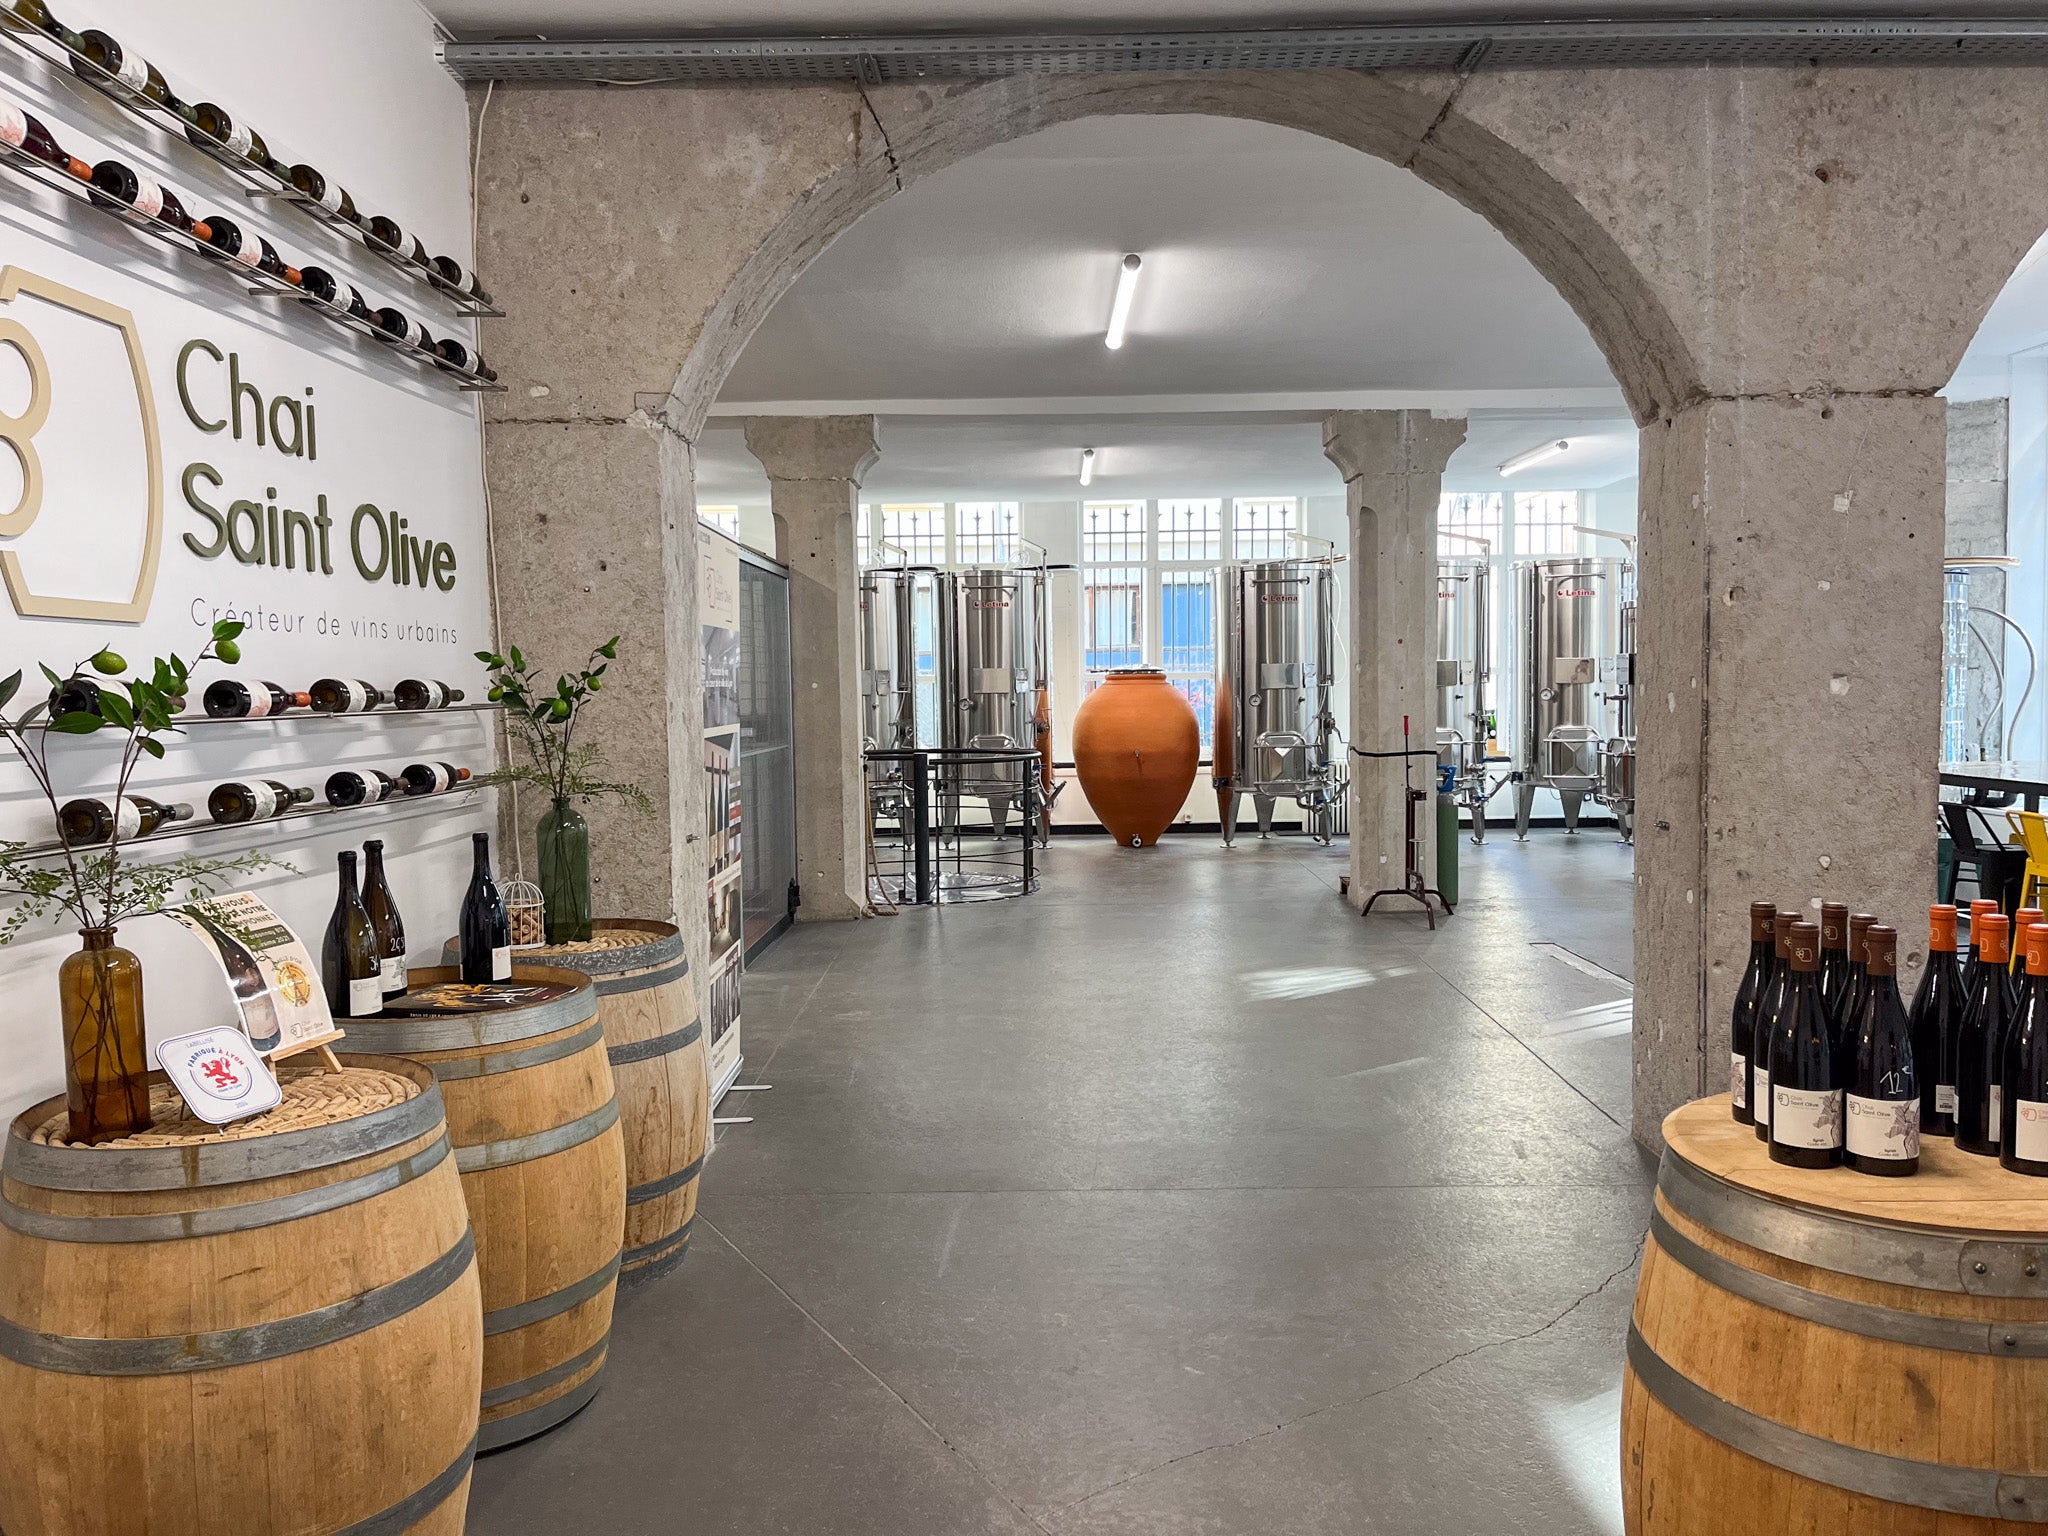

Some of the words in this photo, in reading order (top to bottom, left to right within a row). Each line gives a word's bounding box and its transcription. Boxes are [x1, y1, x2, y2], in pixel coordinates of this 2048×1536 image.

[176, 338, 317, 460] Chai
[181, 462, 334, 575] Saint
[350, 503, 457, 592] Olive
[1565, 589, 1596, 597] Letina
[190, 598, 305, 632] Créateur
[317, 611, 341, 636] de
[350, 617, 389, 640] vins
[396, 619, 458, 645] urbains
[240, 904, 267, 915] NOTRE
[276, 935, 290, 943] 2021
[226, 1050, 245, 1066] LYON
